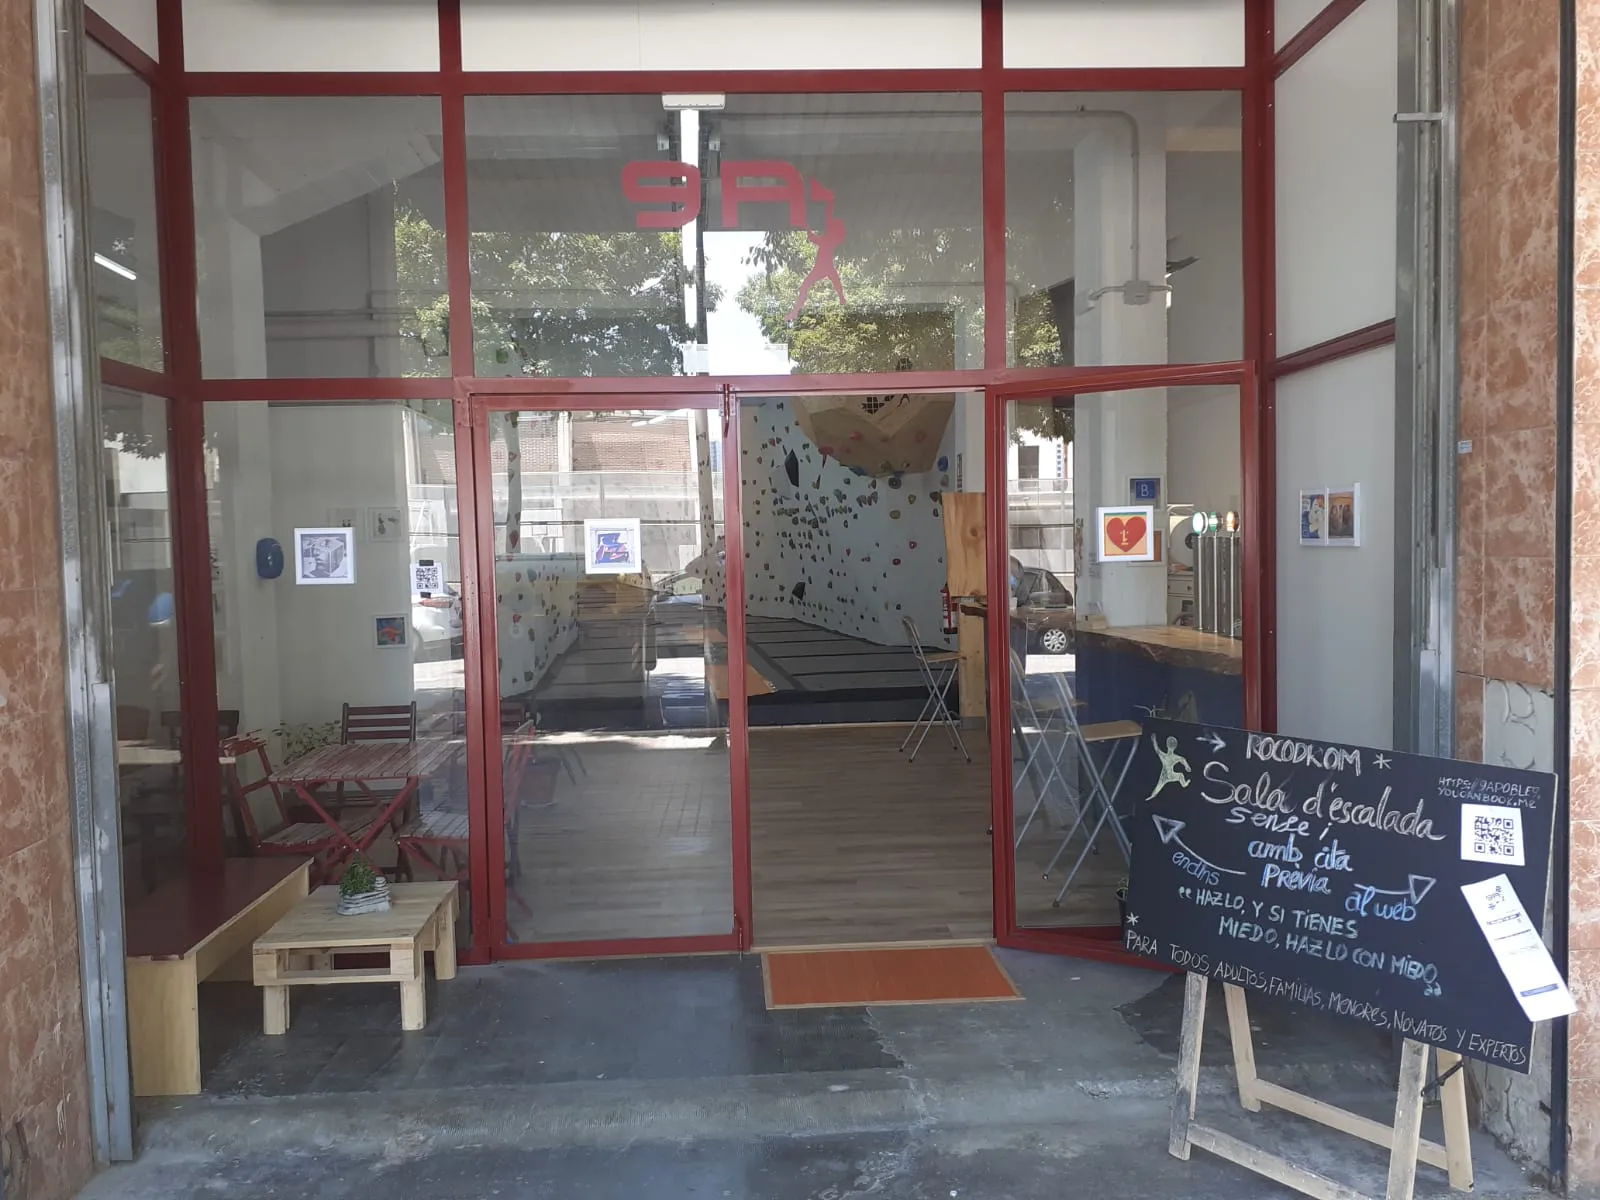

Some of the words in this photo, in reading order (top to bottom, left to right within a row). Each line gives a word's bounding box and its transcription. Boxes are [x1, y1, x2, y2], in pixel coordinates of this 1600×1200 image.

[1246, 733, 1362, 777] ROCODROM
[1201, 760, 1295, 814] Sala
[1225, 806, 1311, 837] sense
[1171, 850, 1220, 886] endins
[1247, 833, 1304, 863] amb
[1314, 838, 1354, 872] cita
[1252, 900, 1264, 919] Y
[1268, 905, 1285, 924] SI
[1374, 896, 1417, 922] web
[1218, 915, 1280, 949] MIEDO,
[1285, 932, 1349, 961] HAZLO
[1352, 947, 1385, 970] CON
[1126, 930, 1158, 955] PARA
[1169, 943, 1210, 976] TODOS,
[1393, 1009, 1448, 1043] NOVATOS
[1456, 1028, 1467, 1049] Y
[1468, 1033, 1527, 1065] EXPERTOS
